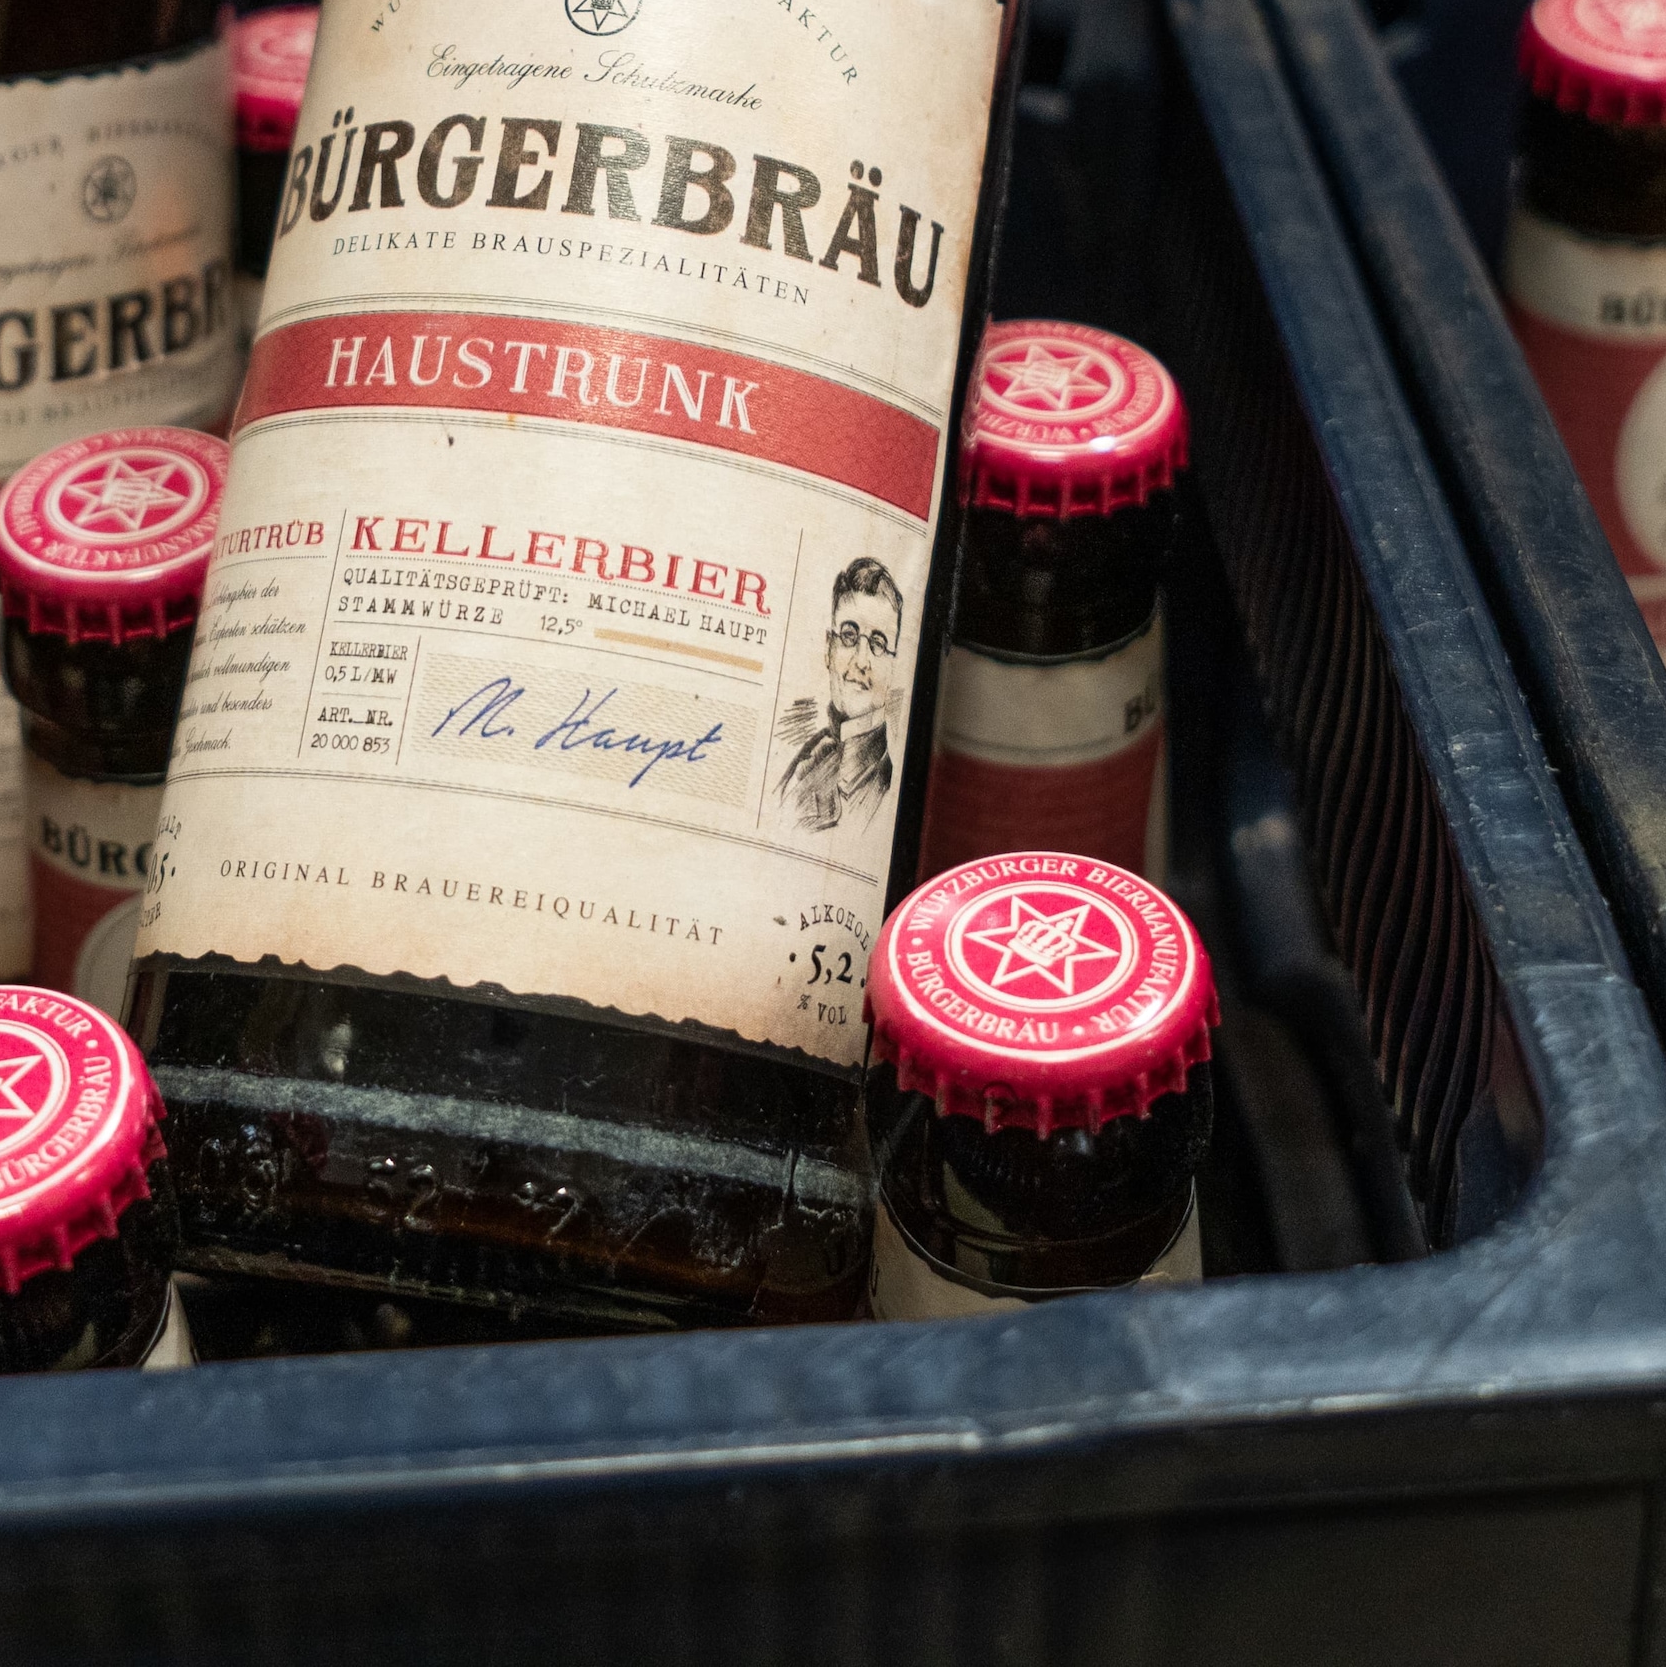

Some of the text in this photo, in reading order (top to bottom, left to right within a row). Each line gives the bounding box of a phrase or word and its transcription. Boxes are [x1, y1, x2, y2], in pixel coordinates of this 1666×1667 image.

[425, 43, 764, 111] Eingetragene Schutzmarke
[279, 106, 945, 309] BÜRGERBRÄU
[333, 230, 811, 307] DELIKATE BRAUSPEZIALITÄTEN
[323, 335, 761, 436] HAUSTRUNK
[349, 515, 772, 616] KELLERBIER
[250, 615, 308, 636] schätzen
[338, 595, 505, 626] STAMMWÜRZE
[343, 567, 769, 646] QUALITÄTSGEPRÜFT: MICHAEL HAUPT
[329, 640, 409, 661] KELLERBIER
[311, 733, 391, 754] 20 000 853
[431, 677, 724, 790] M. Haupt
[219, 858, 724, 947] ORIGINAL BRAUEREIQUALITÄT
[799, 903, 870, 952] ALKOHOL
[905, 857, 1180, 1035] WÜRZBURGER BIERMANUFAKTUR
[817, 1001, 848, 1025] VOL
[905, 950, 1060, 1044] BÜRGERBRÄU
